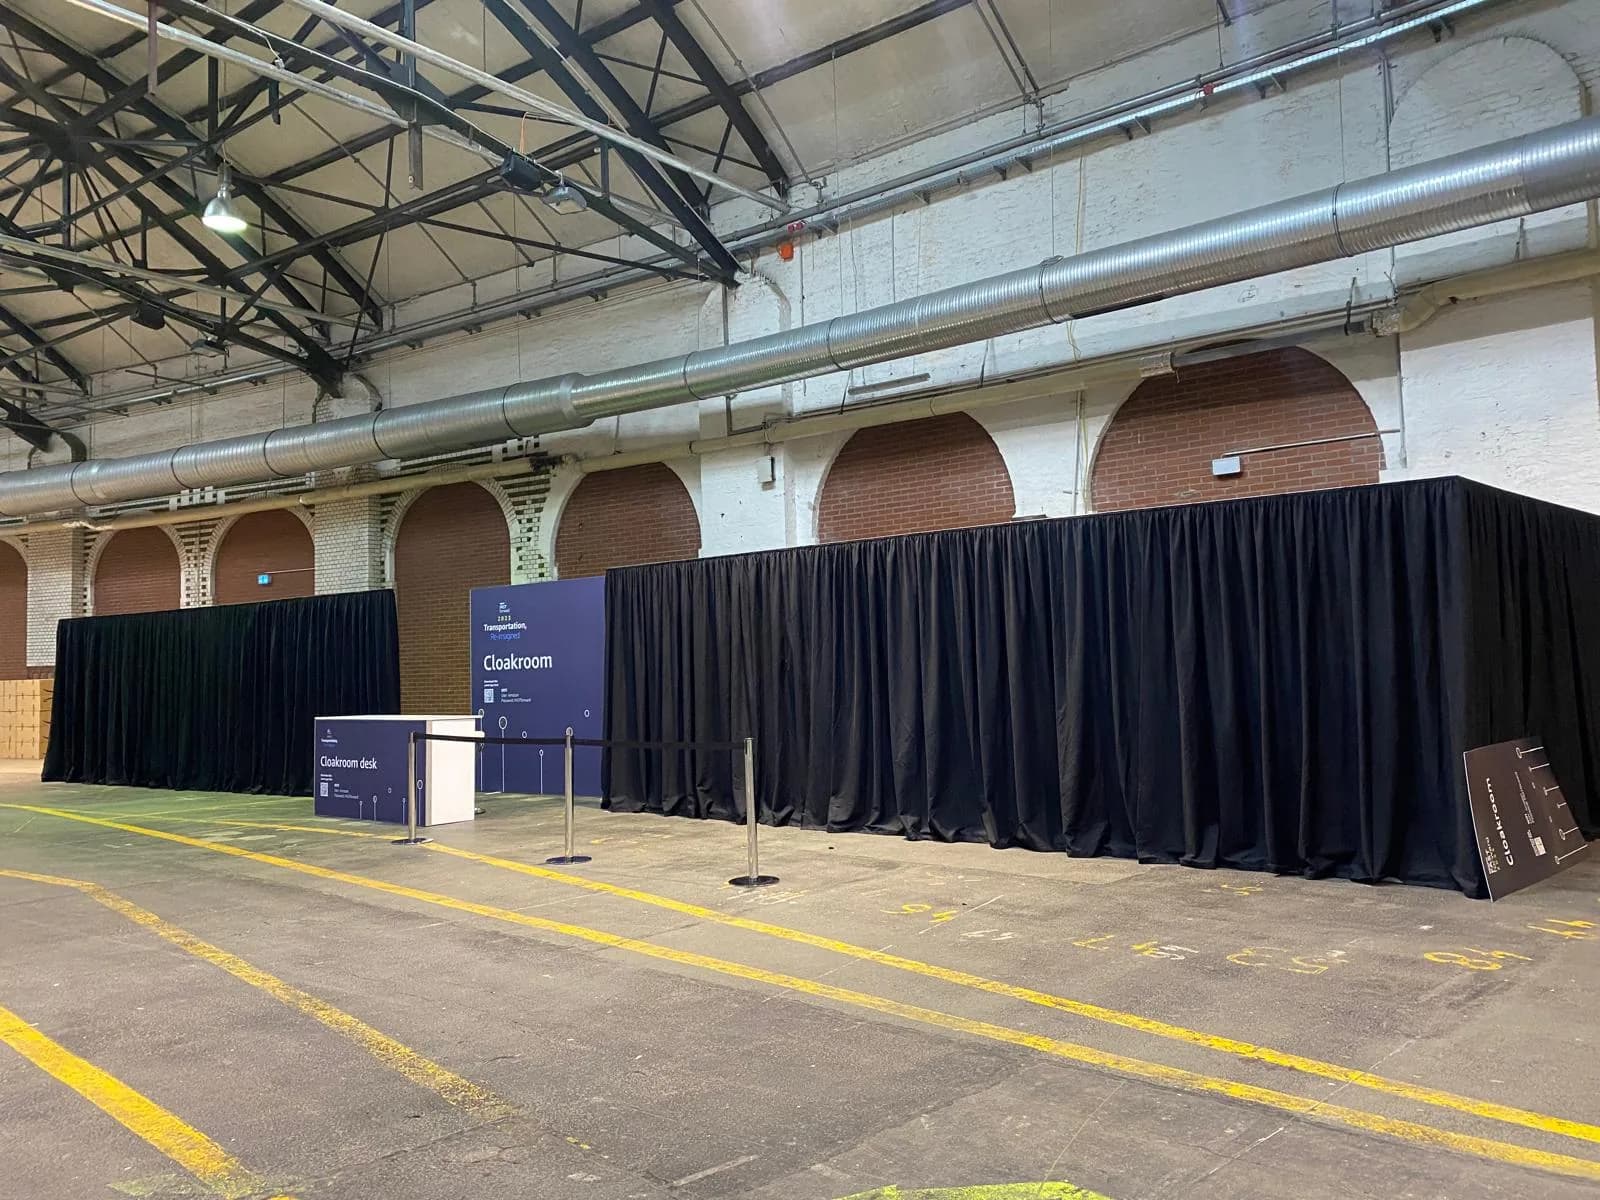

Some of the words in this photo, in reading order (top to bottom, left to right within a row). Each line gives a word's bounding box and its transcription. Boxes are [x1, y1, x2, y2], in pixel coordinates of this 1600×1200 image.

[483, 622, 527, 632] Transportation,
[483, 653, 552, 670] Cloakroom
[320, 755, 359, 769] Cloakroom
[359, 756, 377, 770] desk
[1486, 777, 1514, 866] Cloakroom
